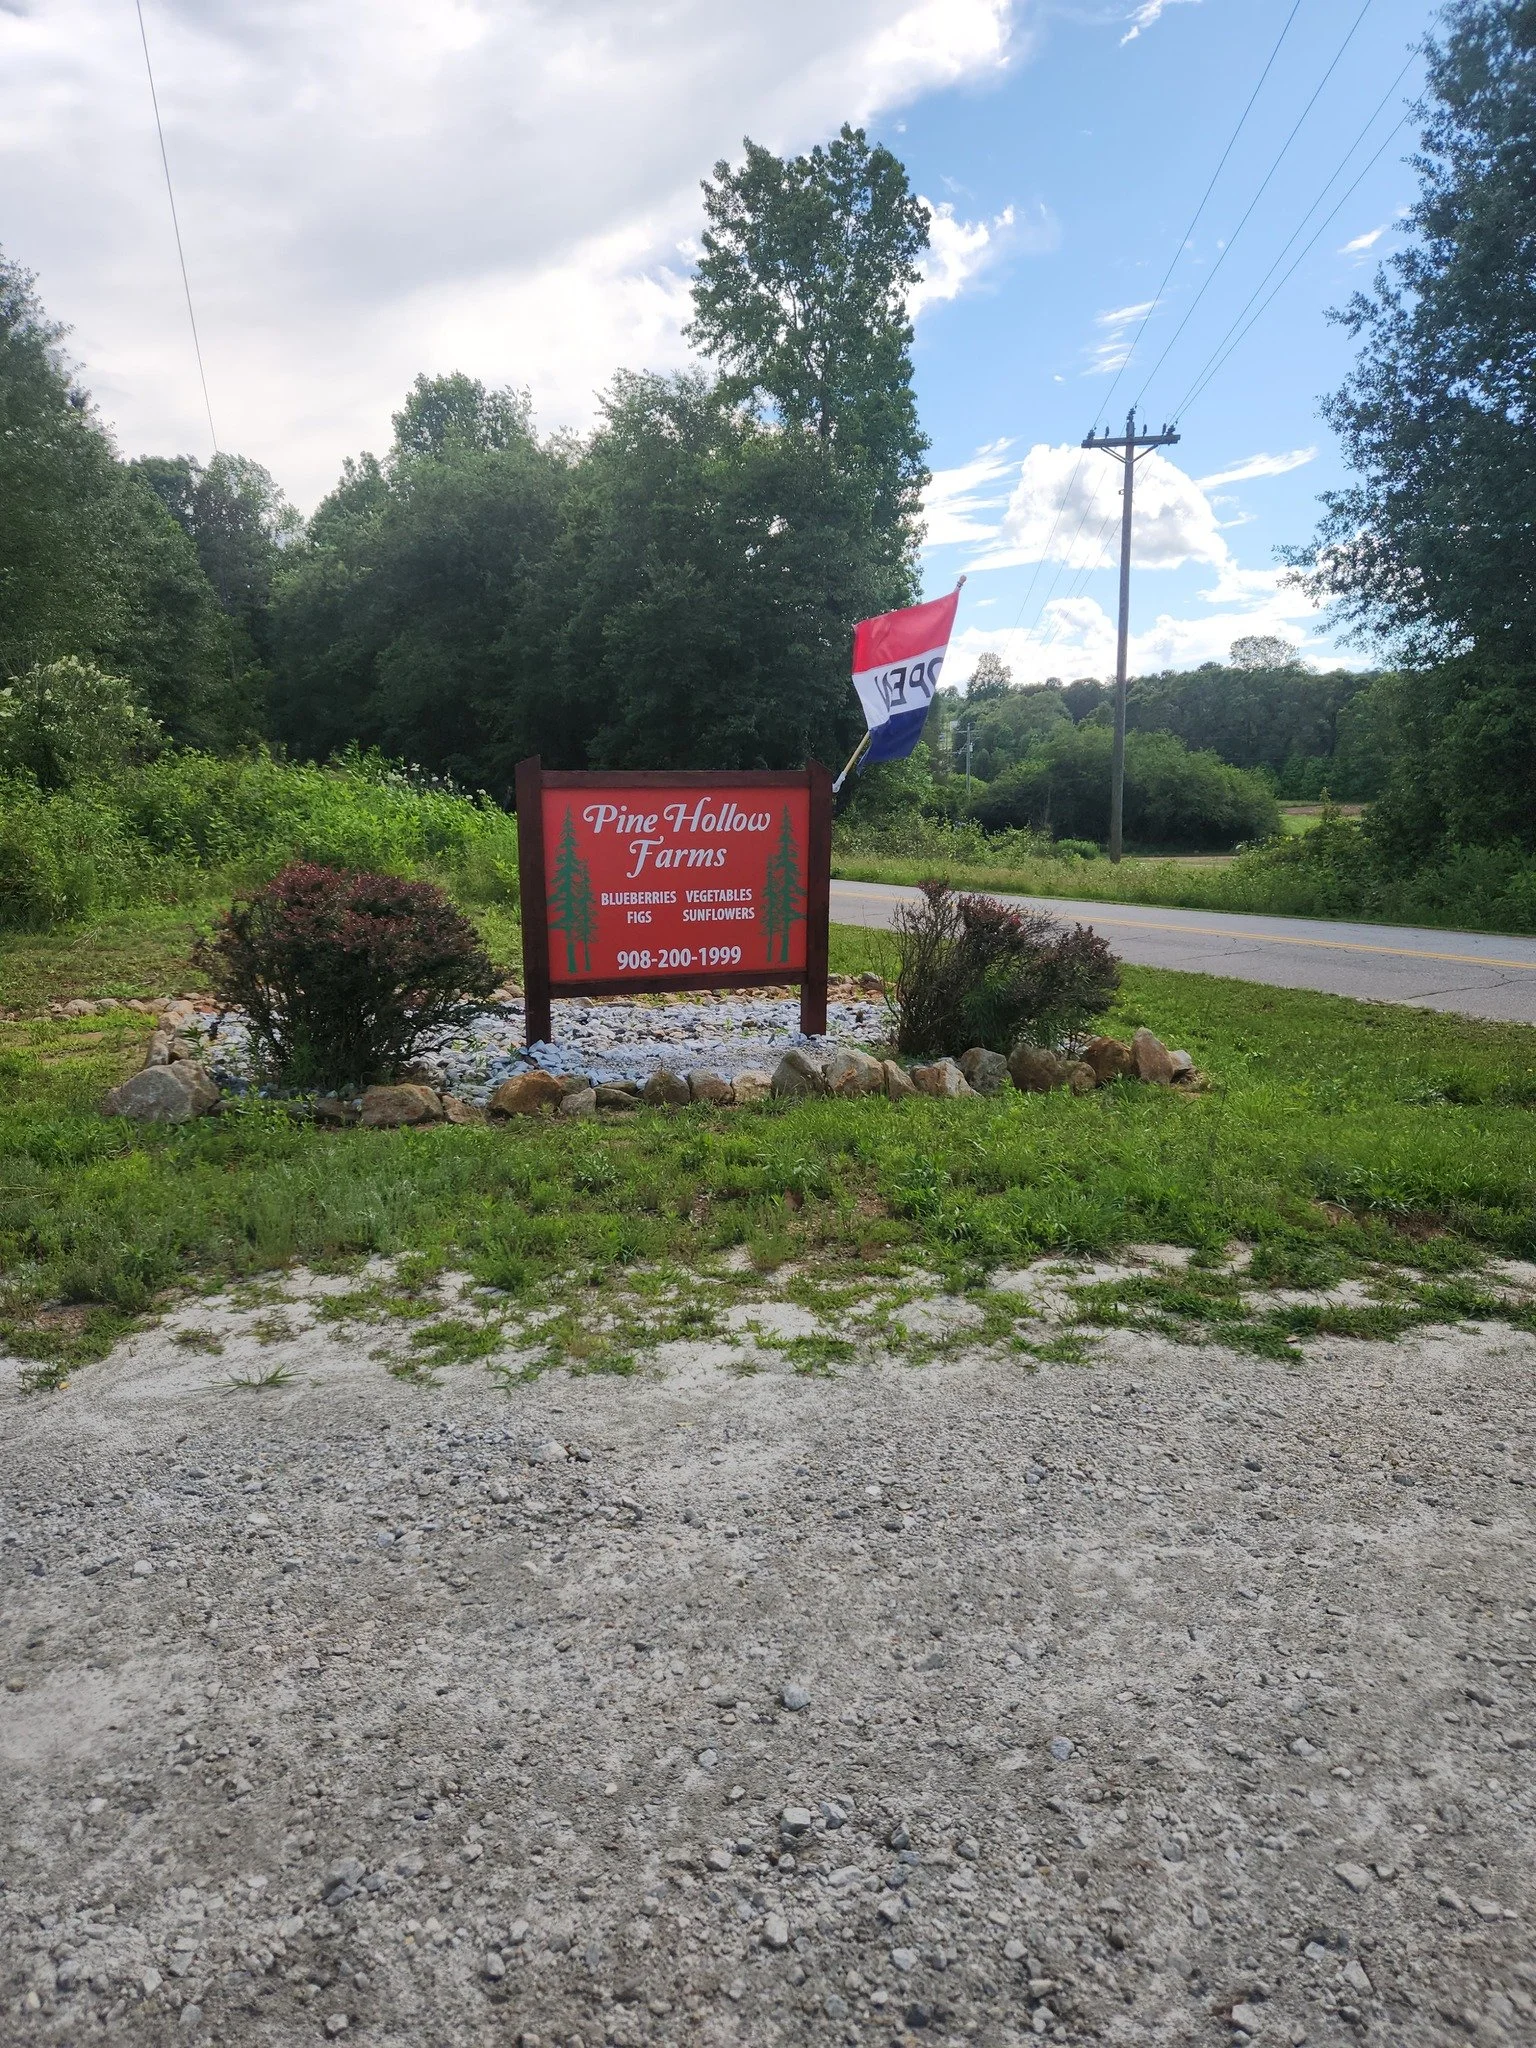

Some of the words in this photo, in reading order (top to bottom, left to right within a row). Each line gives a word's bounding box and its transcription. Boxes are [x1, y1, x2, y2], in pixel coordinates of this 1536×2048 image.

[583, 804, 658, 834] Pine
[663, 797, 771, 833] Hollow
[627, 836, 727, 878] Farms
[601, 891, 677, 906] BLUEBERRIES
[686, 889, 752, 903] VEGETABLES
[627, 911, 652, 924] FIGS
[682, 907, 755, 922] SUNFLOWERS
[617, 946, 742, 970] 908-200-1999
